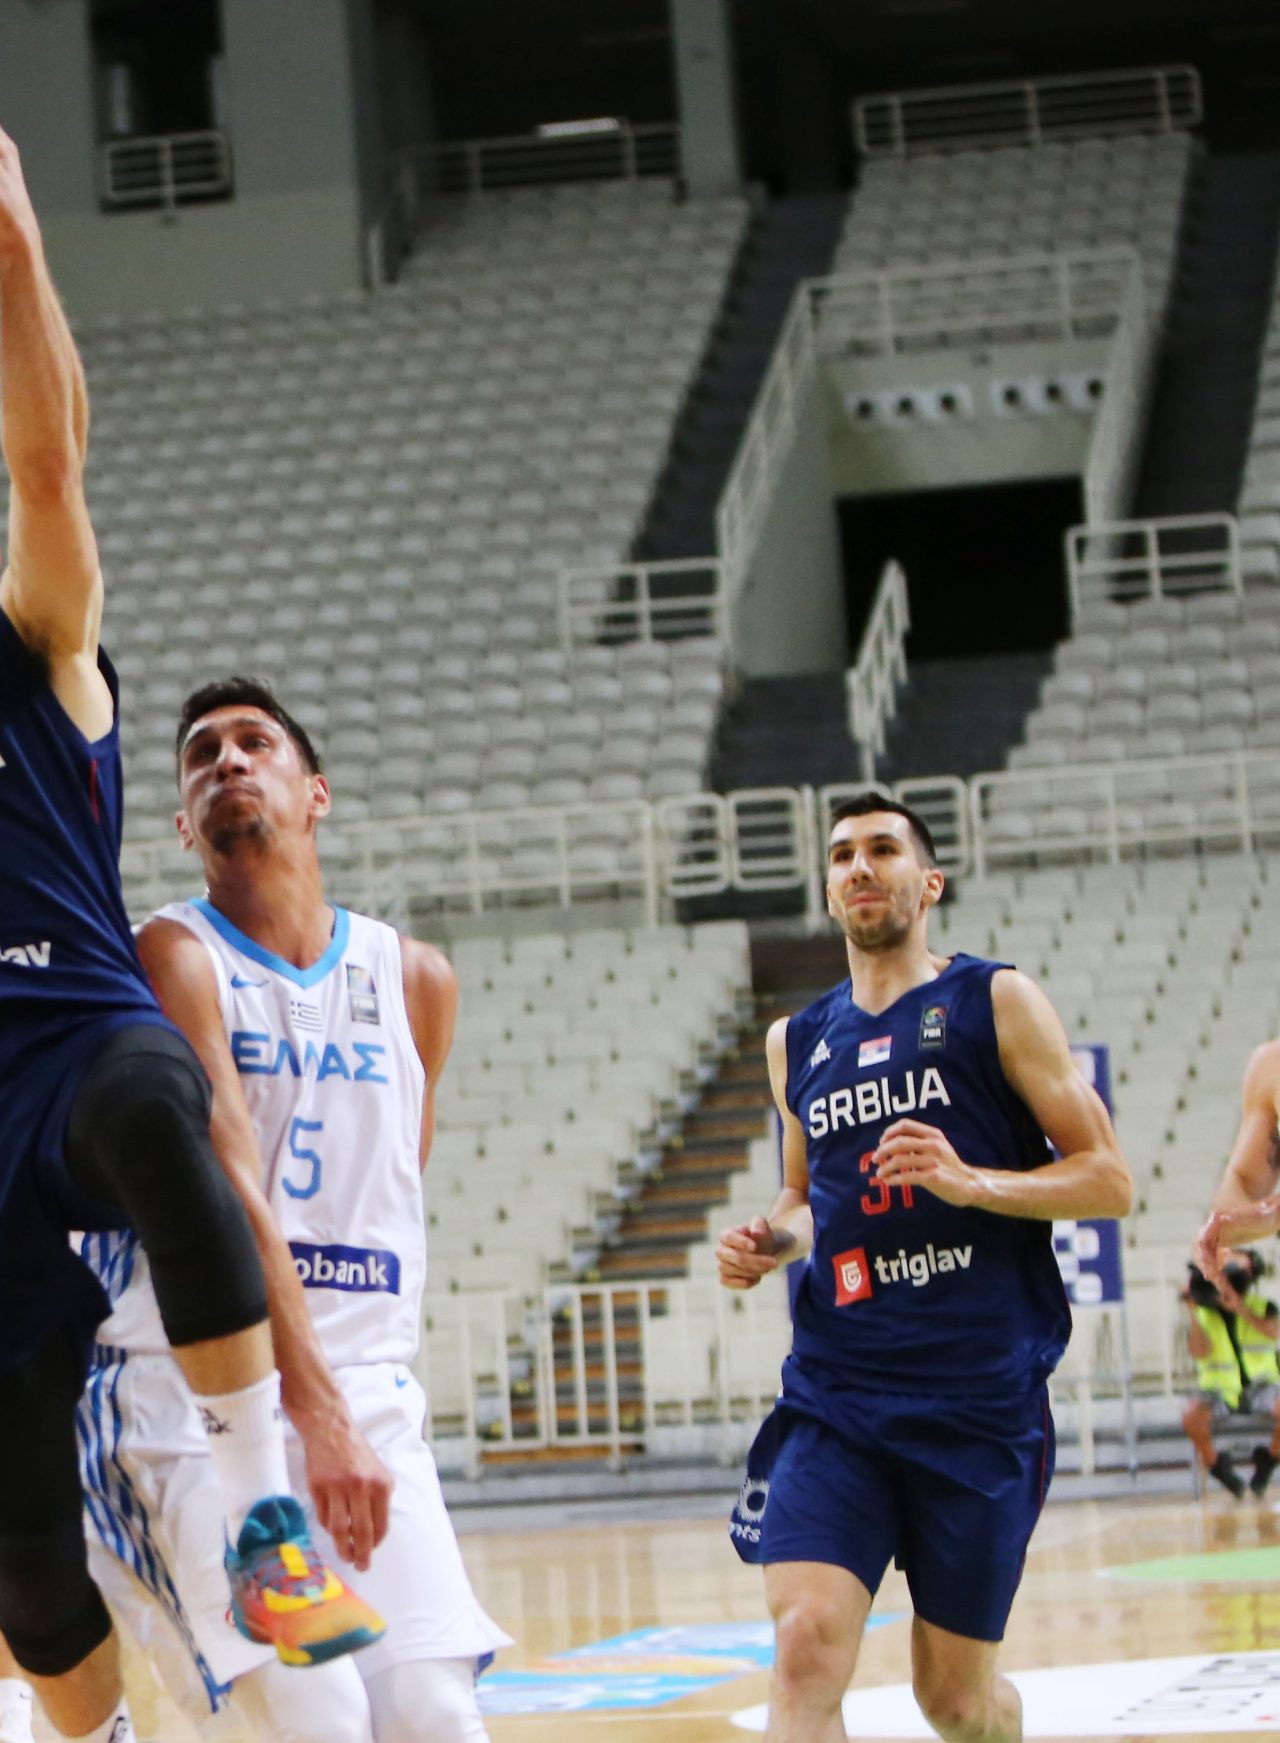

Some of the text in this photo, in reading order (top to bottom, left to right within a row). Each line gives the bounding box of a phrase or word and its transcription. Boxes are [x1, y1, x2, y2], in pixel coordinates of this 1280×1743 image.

[808, 1067, 951, 1140] SRBIJA
[281, 1117, 324, 1200] 5
[874, 1243, 973, 1287] triglav
